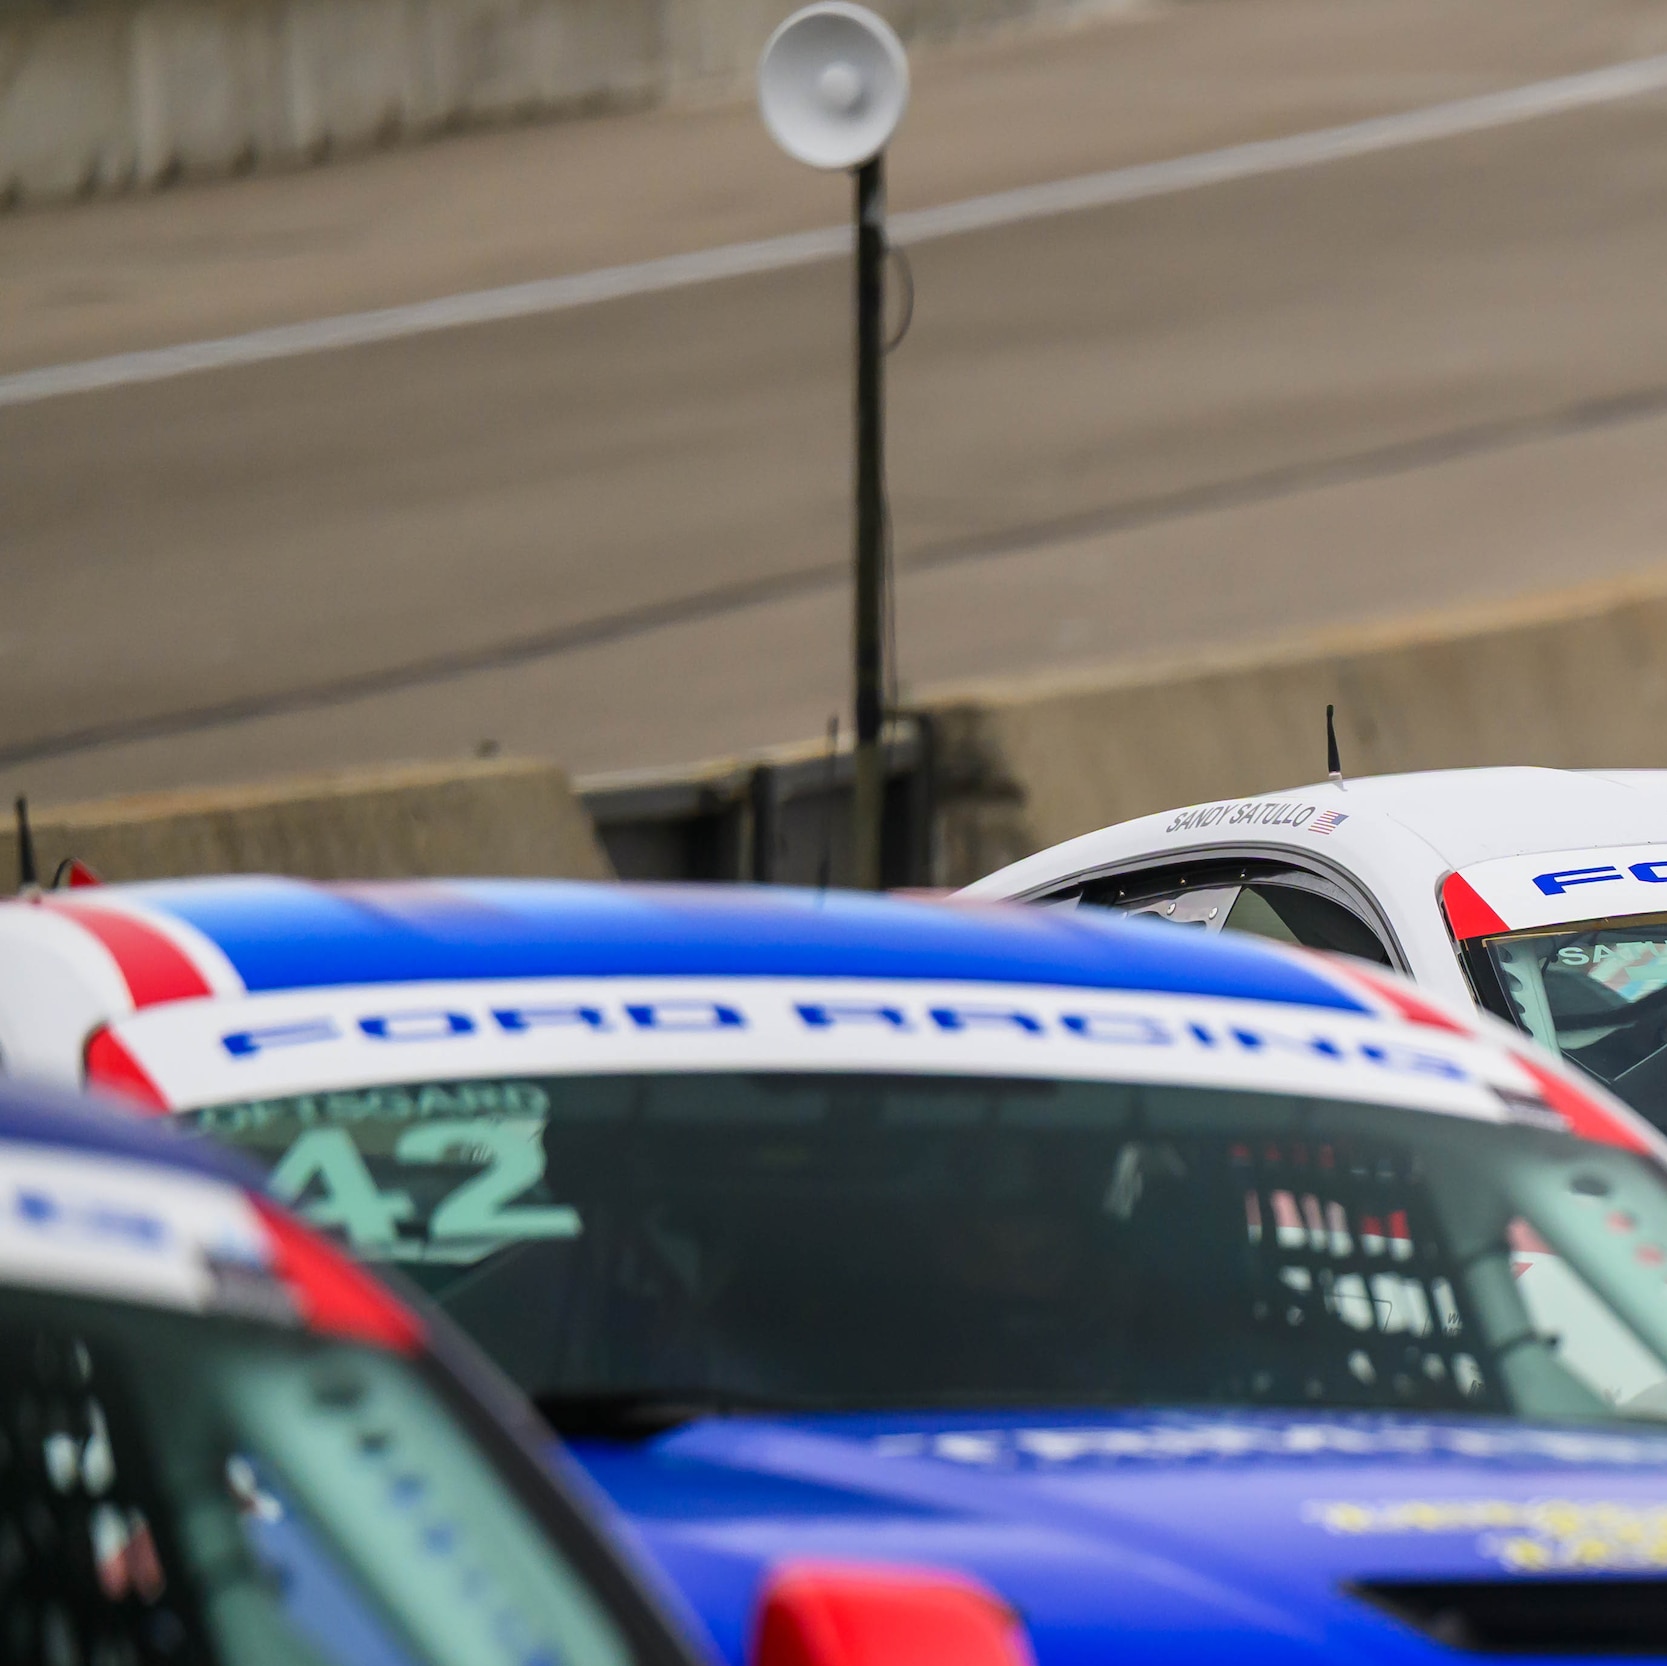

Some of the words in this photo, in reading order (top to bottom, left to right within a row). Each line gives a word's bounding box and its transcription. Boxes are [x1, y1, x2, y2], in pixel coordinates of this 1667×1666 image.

[1166, 804, 1236, 833] SANDY
[1229, 803, 1316, 827] SATULLO
[220, 1001, 750, 1059] FORD
[793, 1002, 1471, 1084] RACING
[268, 1116, 585, 1254] 42
